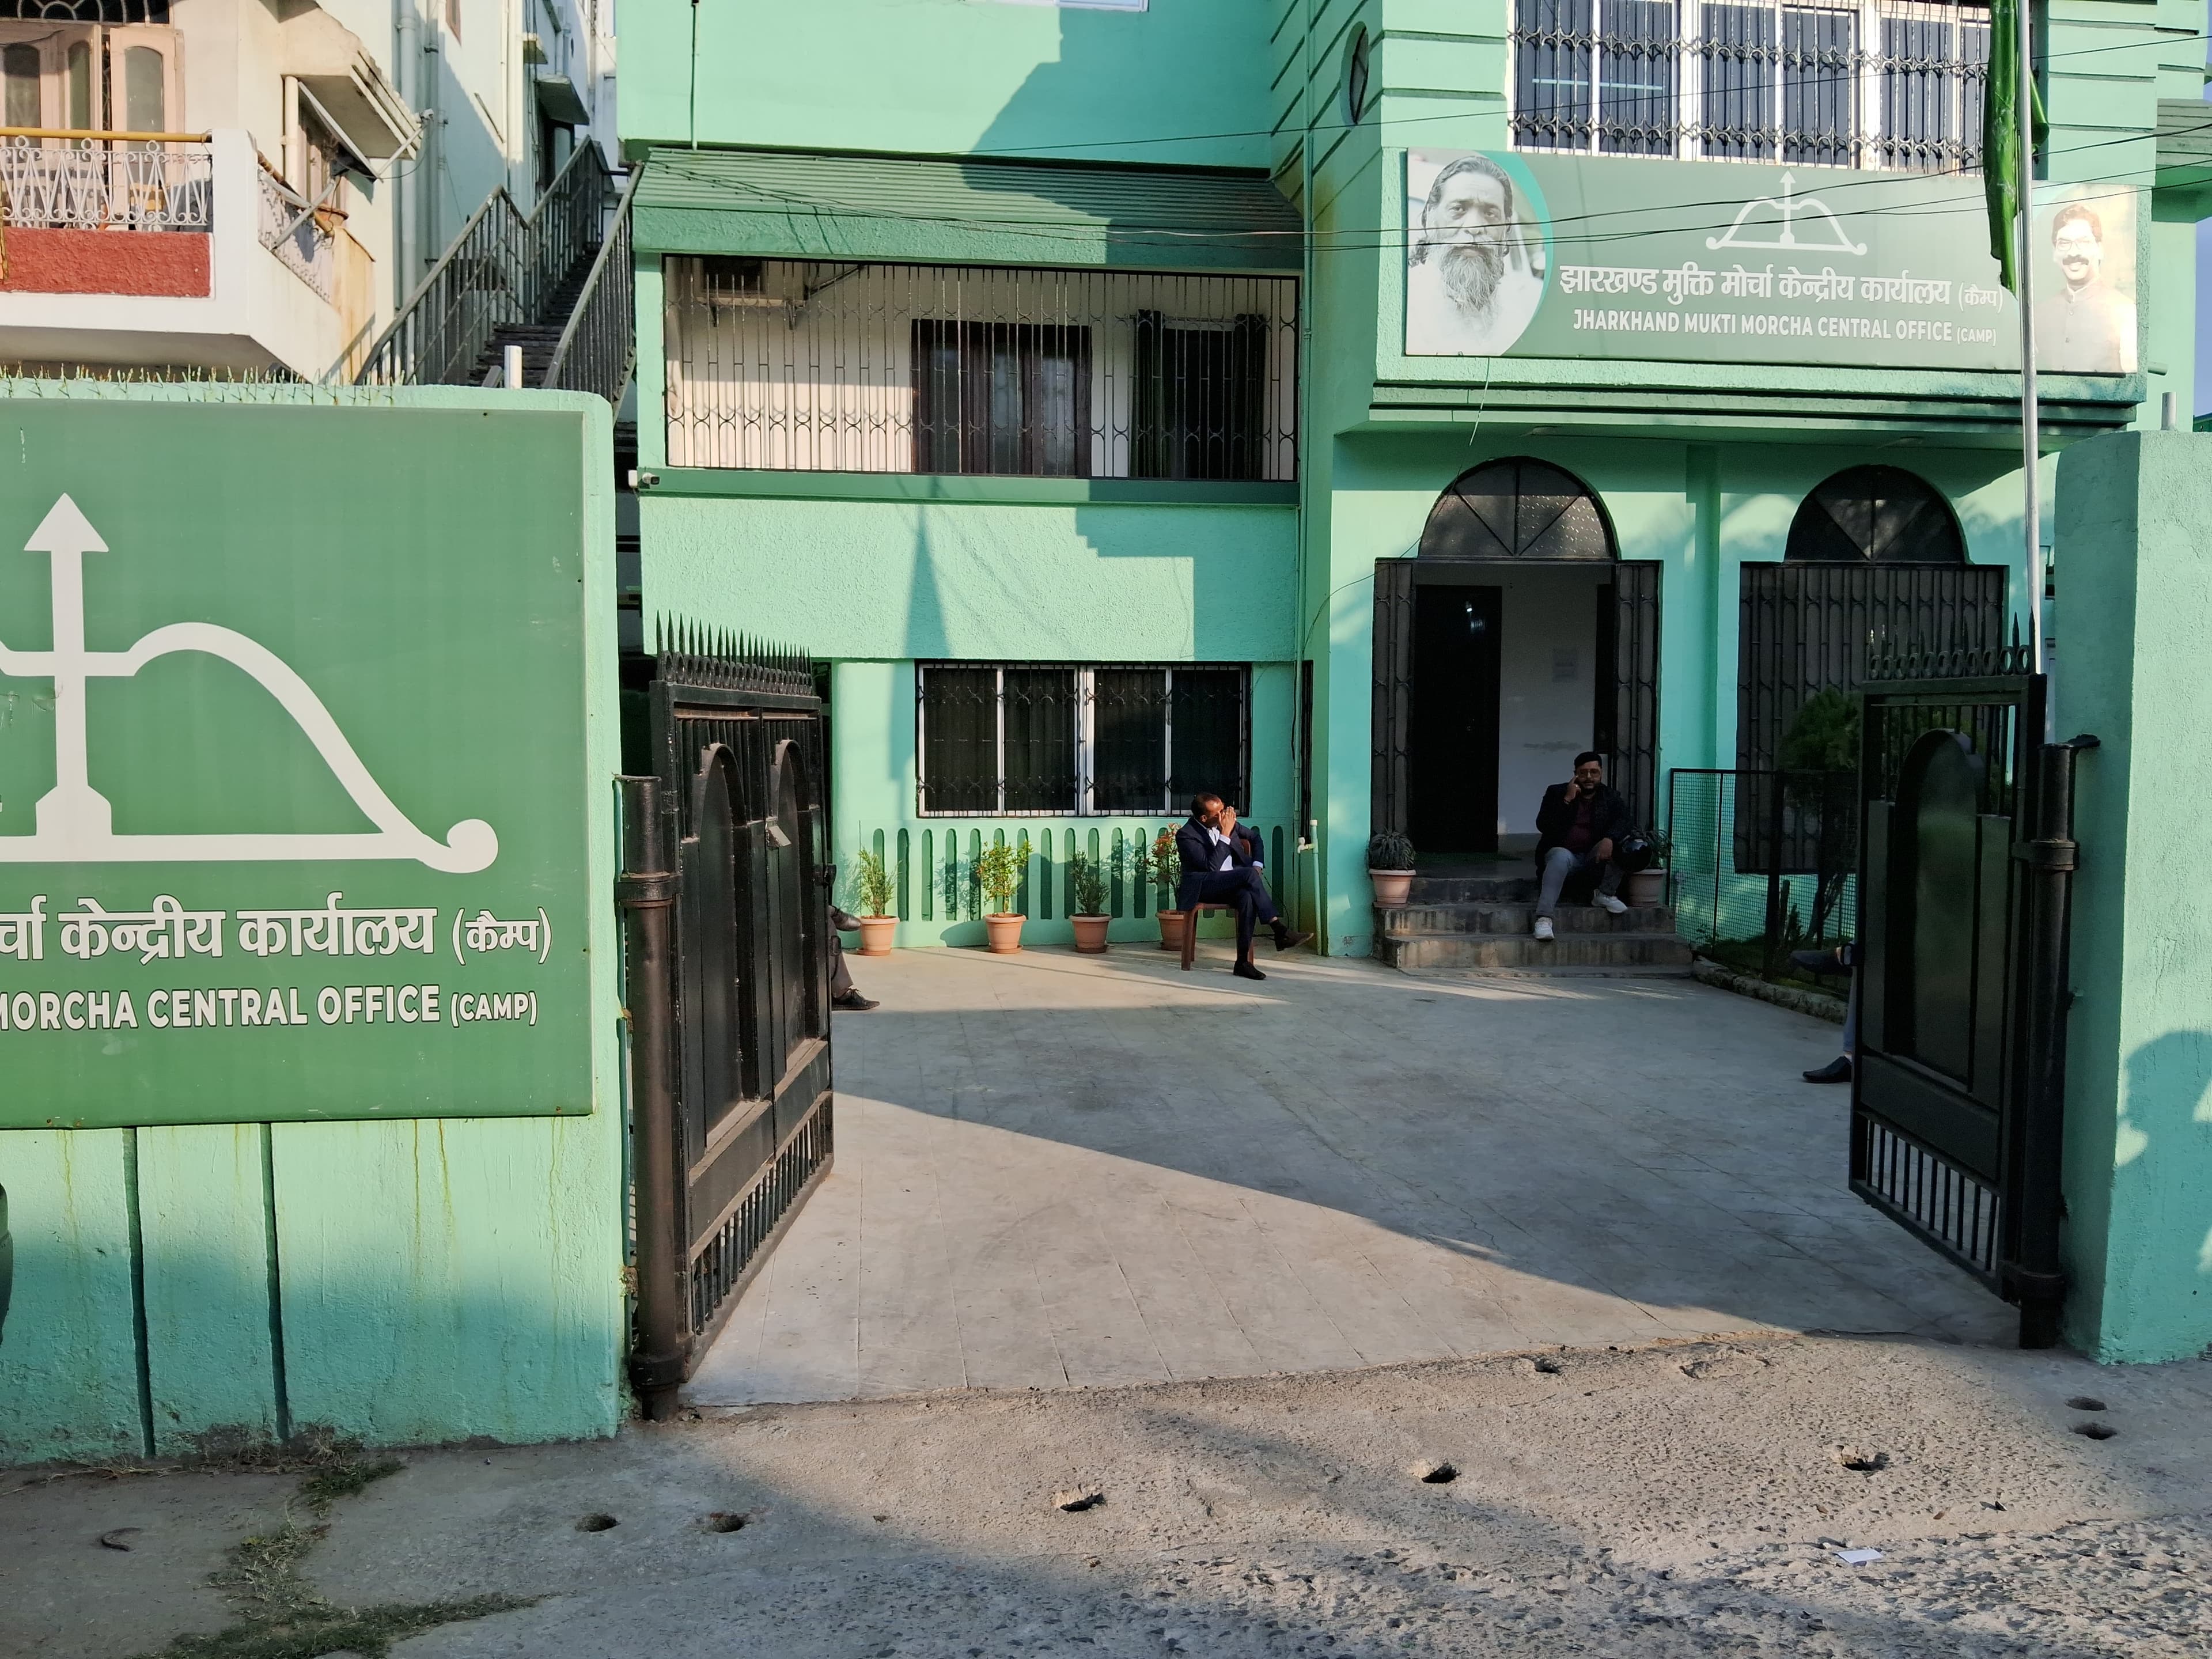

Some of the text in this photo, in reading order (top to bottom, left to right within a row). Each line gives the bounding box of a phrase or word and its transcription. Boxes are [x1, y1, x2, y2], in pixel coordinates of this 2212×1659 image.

[1559, 266, 1660, 294] झारखण्ड
[1662, 261, 1716, 305] मुक्ति
[1721, 264, 1774, 298] मोर्चा
[1778, 266, 1856, 302] केन्द्रीय
[1860, 270, 1952, 305] कार्यालय
[1573, 309, 1997, 347] JHARKHAND MUKTI MORCHA CENTRAL OFFICE (CAMP)
[57, 894, 226, 965] केन्द्रीय
[236, 891, 438, 957] कार्यालय
[452, 907, 552, 965] (कैम्प)
[146, 988, 308, 1028] CENTRAL
[317, 984, 440, 1025] OFFICE
[450, 991, 538, 1028] (CAMP)
